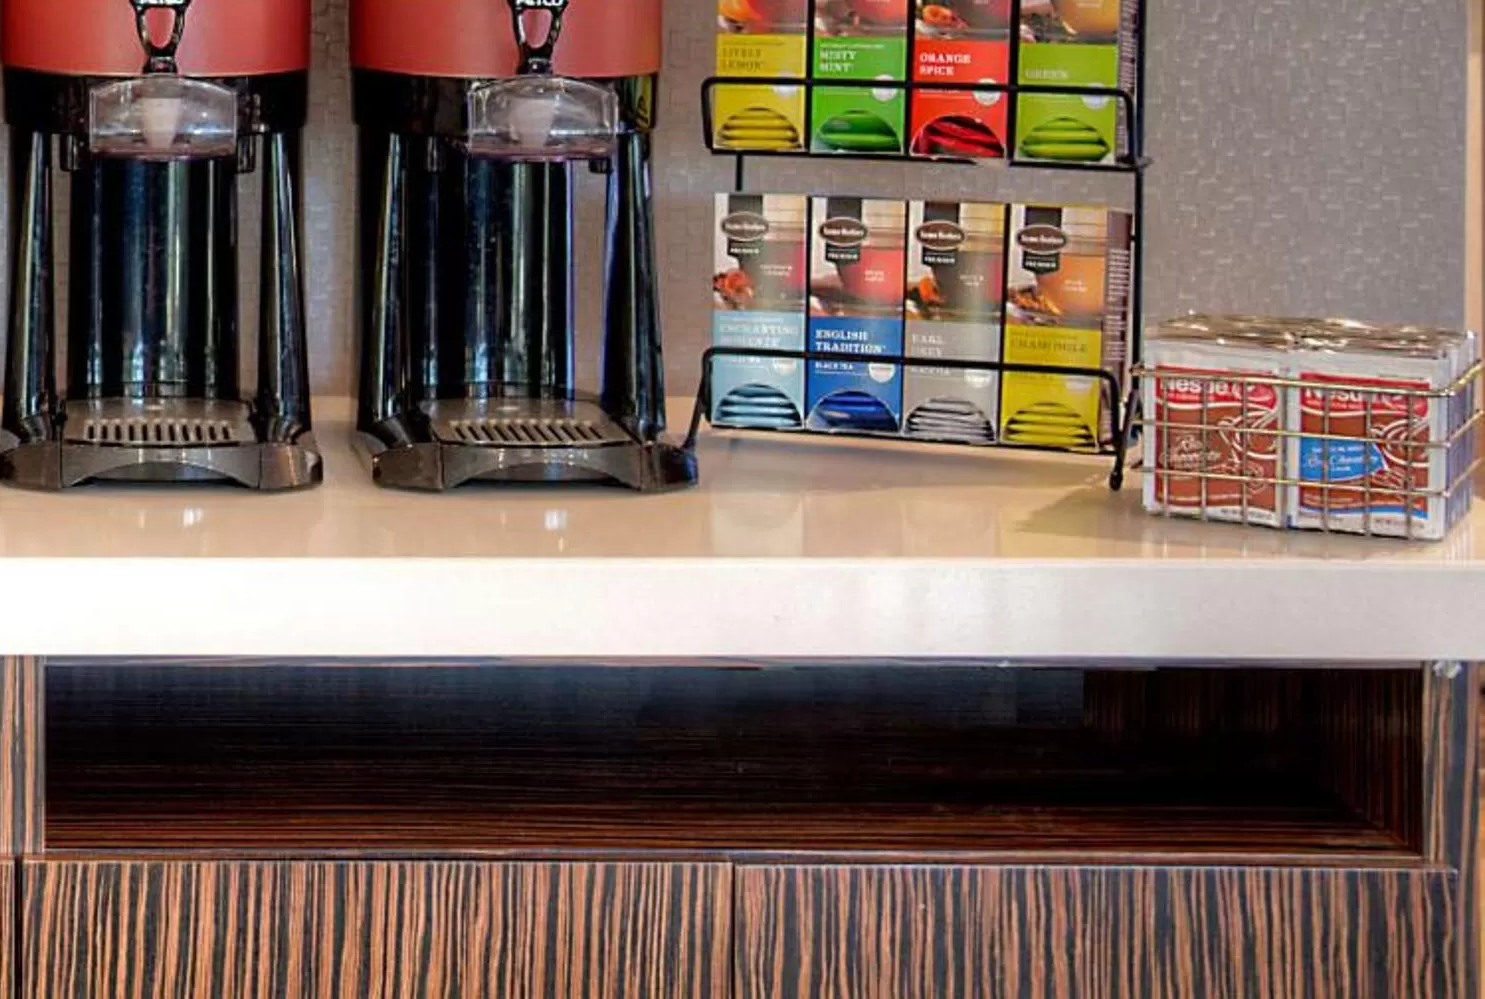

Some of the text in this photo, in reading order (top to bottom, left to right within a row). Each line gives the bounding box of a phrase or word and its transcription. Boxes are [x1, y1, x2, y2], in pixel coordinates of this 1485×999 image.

[919, 53, 971, 64] ORANGE
[919, 65, 955, 76] SPICE
[816, 329, 869, 341] ENGLISH
